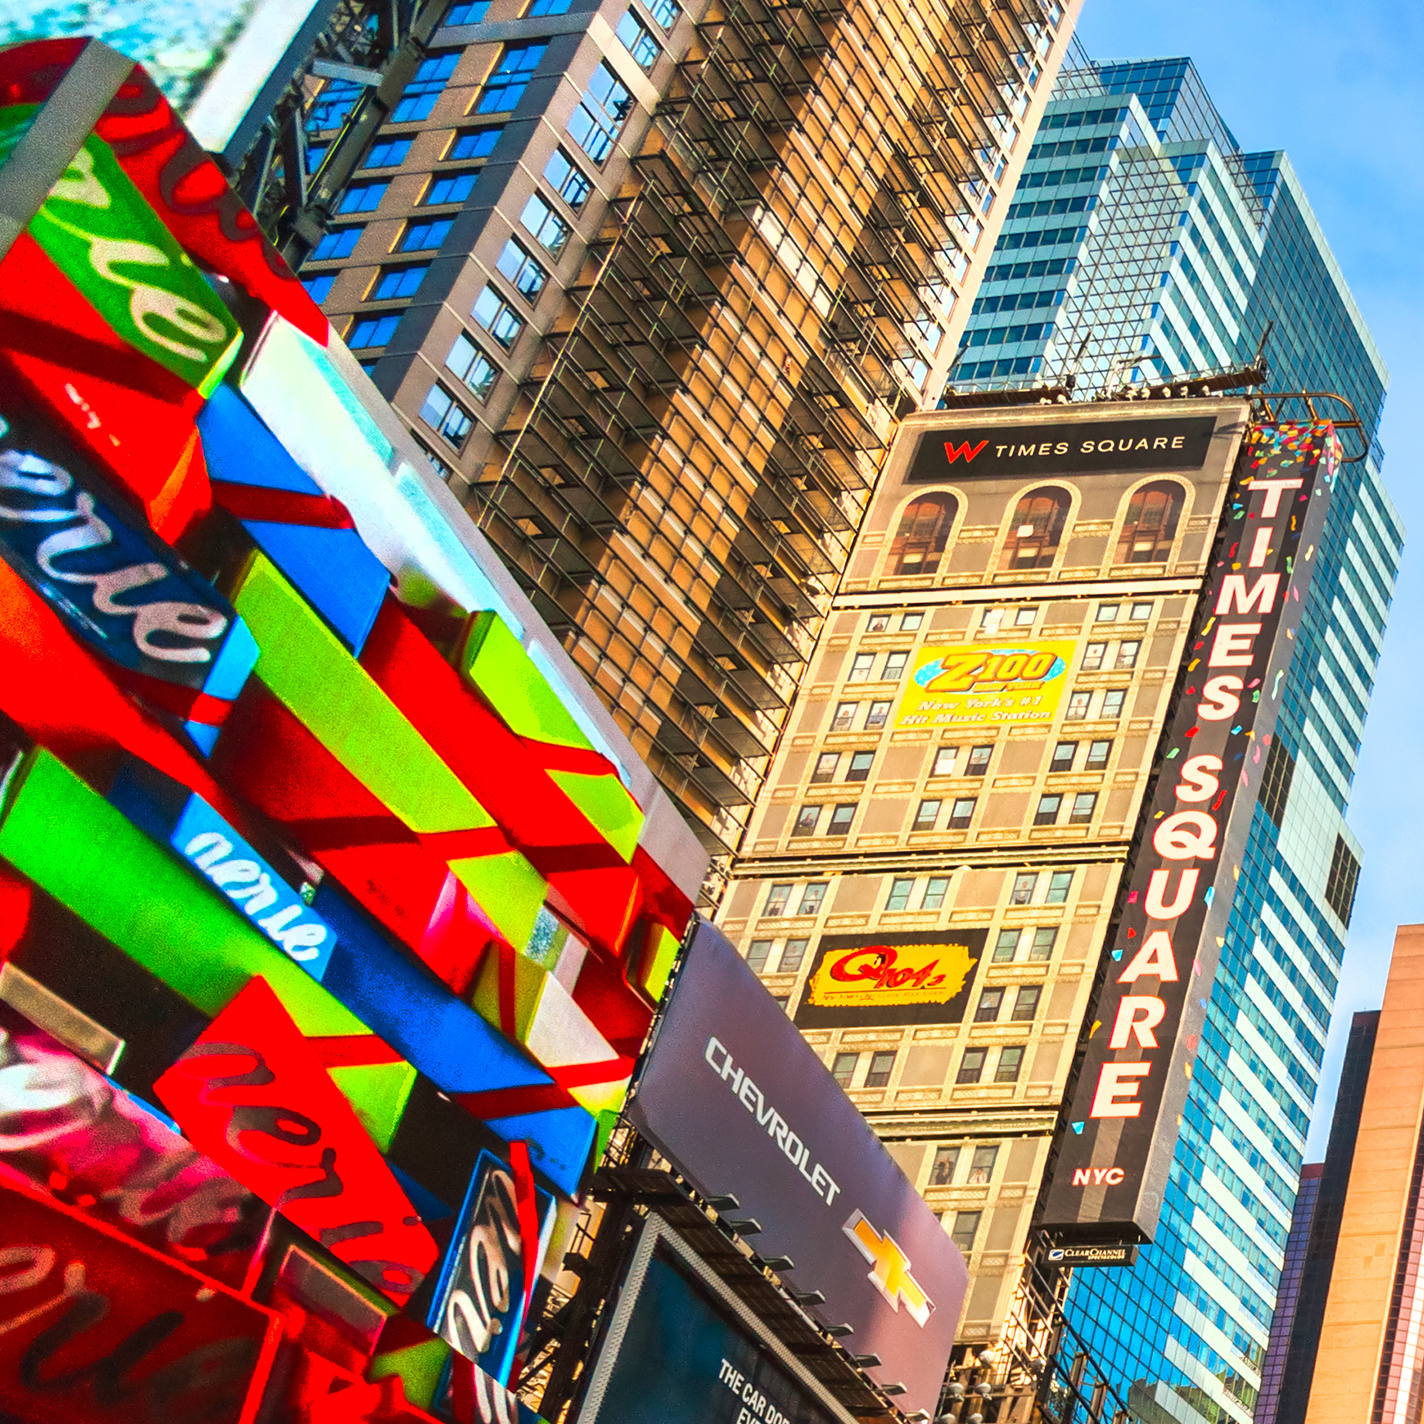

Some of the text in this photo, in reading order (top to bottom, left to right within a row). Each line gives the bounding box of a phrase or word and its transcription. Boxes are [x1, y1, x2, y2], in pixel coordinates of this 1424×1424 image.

[944, 435, 1185, 464] W TIMES SQUARE
[925, 652, 1058, 693] Z100
[900, 711, 1051, 725] Hit Music Station
[917, 696, 1042, 711] New York's #1
[1088, 478, 1303, 1119] TIMES SQUARE
[183, 830, 328, 963] aerie
[705, 1036, 841, 1205] CHEVROLET
[1073, 1167, 1124, 1187] NYC
[718, 1359, 744, 1391] THE
[741, 1380, 768, 1415] CAR
